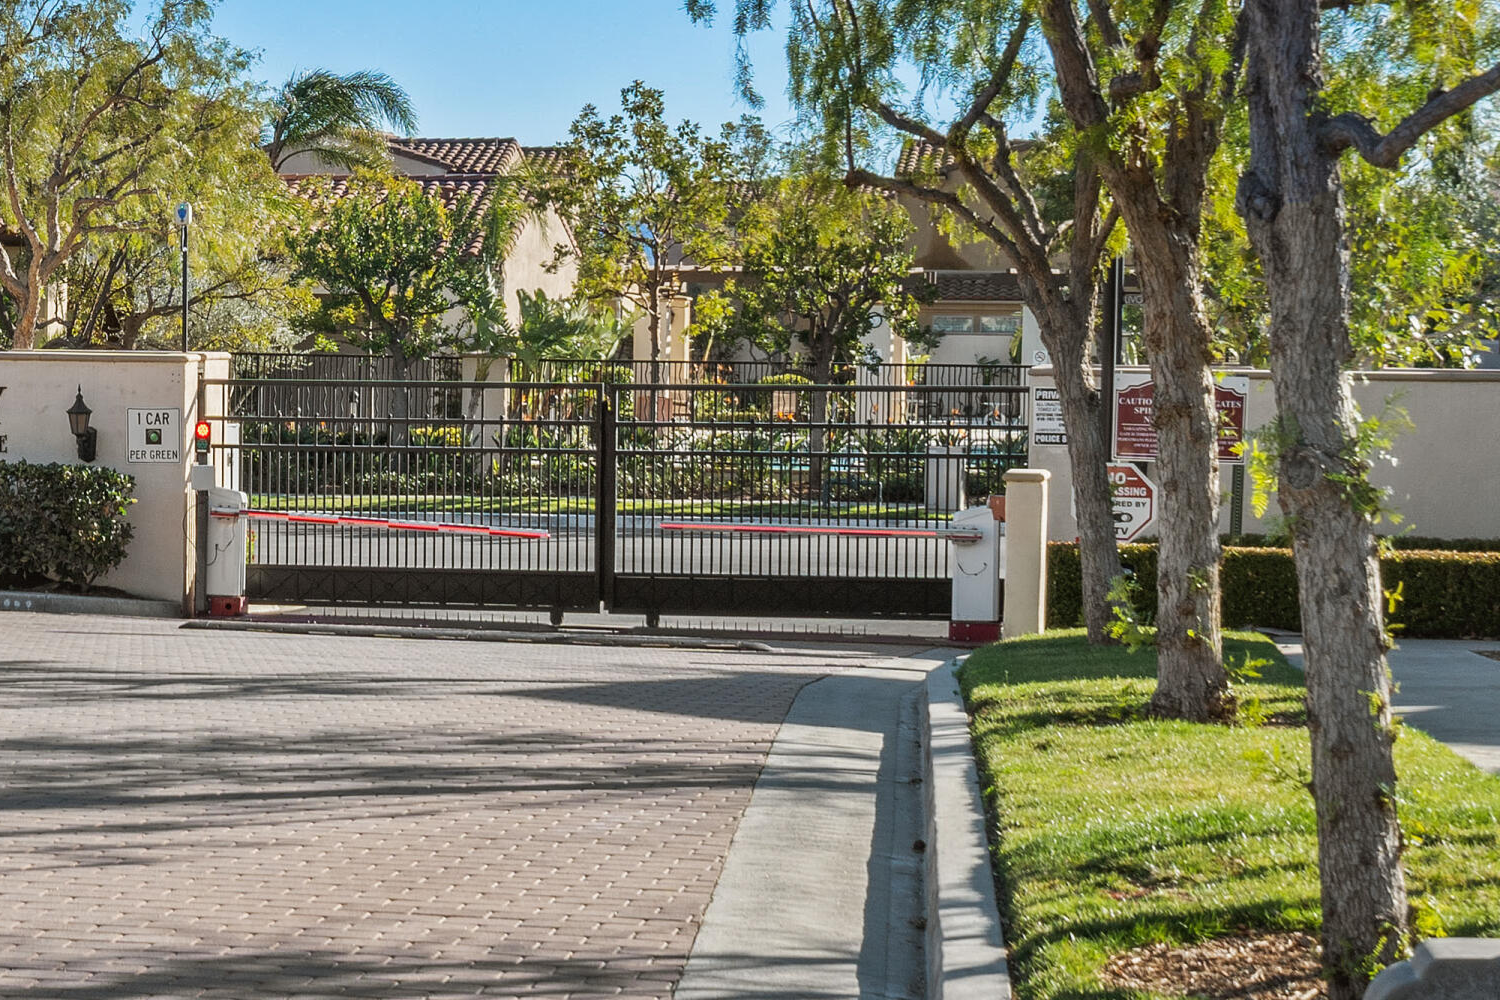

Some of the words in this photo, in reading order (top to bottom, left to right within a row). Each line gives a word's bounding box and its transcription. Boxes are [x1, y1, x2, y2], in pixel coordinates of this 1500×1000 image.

[146, 412, 169, 425] CAR
[130, 450, 146, 460] PER
[150, 450, 178, 459] GREEN
[1114, 487, 1146, 496] SSING
